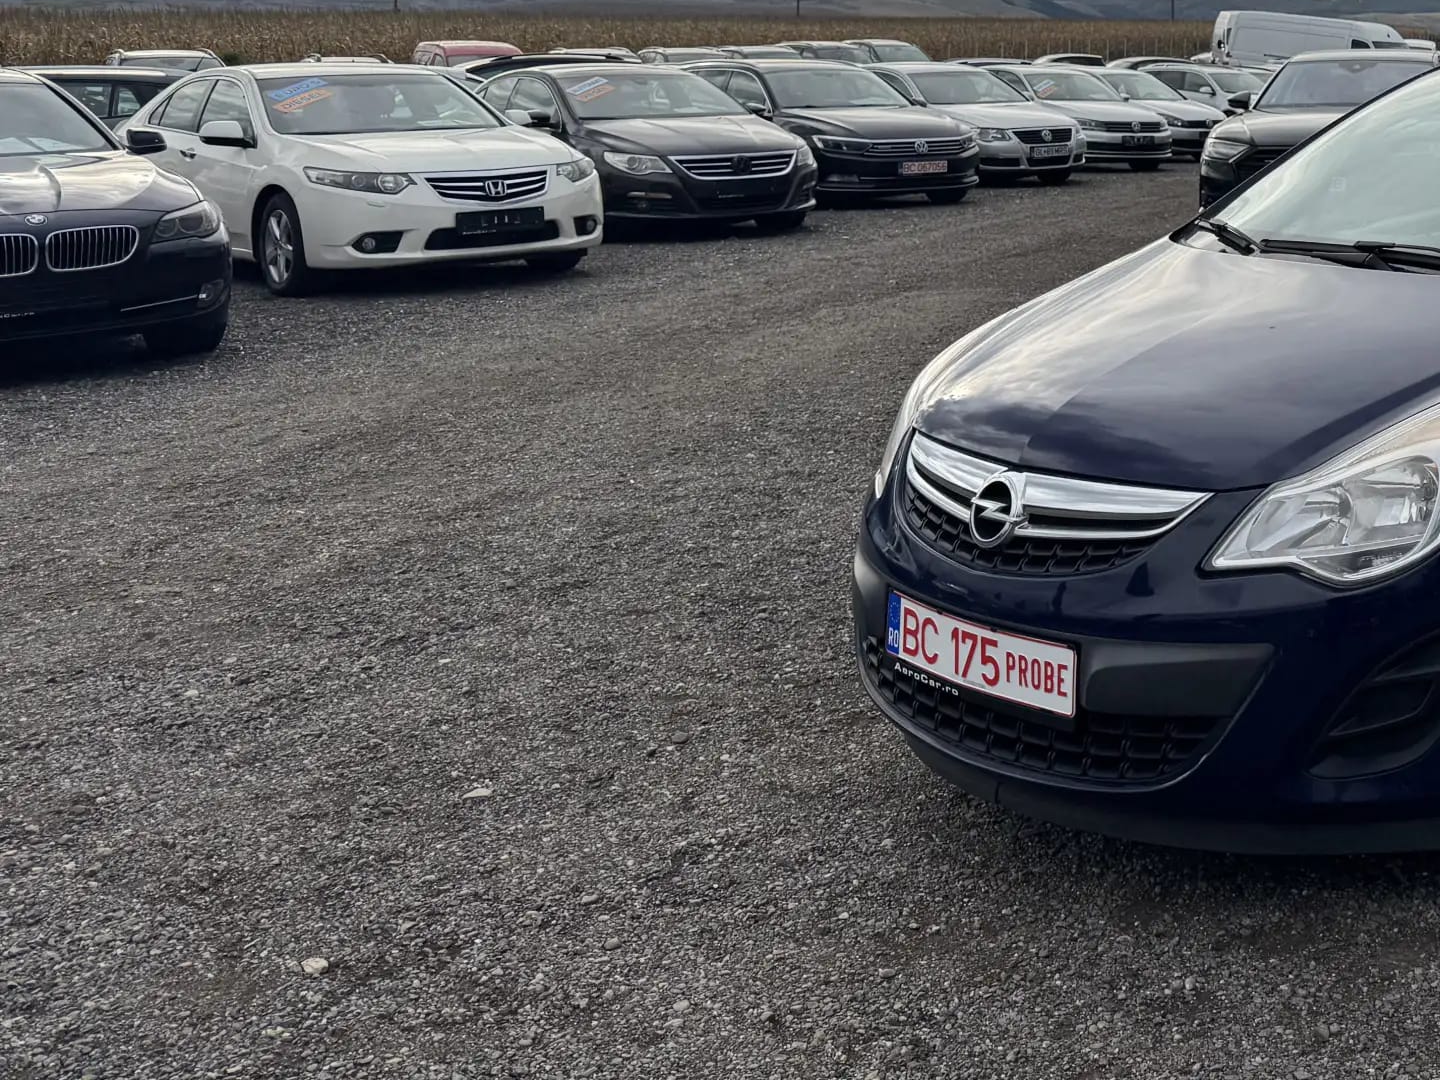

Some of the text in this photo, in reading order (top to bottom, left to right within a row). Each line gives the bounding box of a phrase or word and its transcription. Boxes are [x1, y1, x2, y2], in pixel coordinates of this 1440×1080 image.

[888, 627, 900, 648] RO
[902, 606, 1068, 698] BC 175 PROBE
[894, 662, 959, 696] AeroCar.ro
